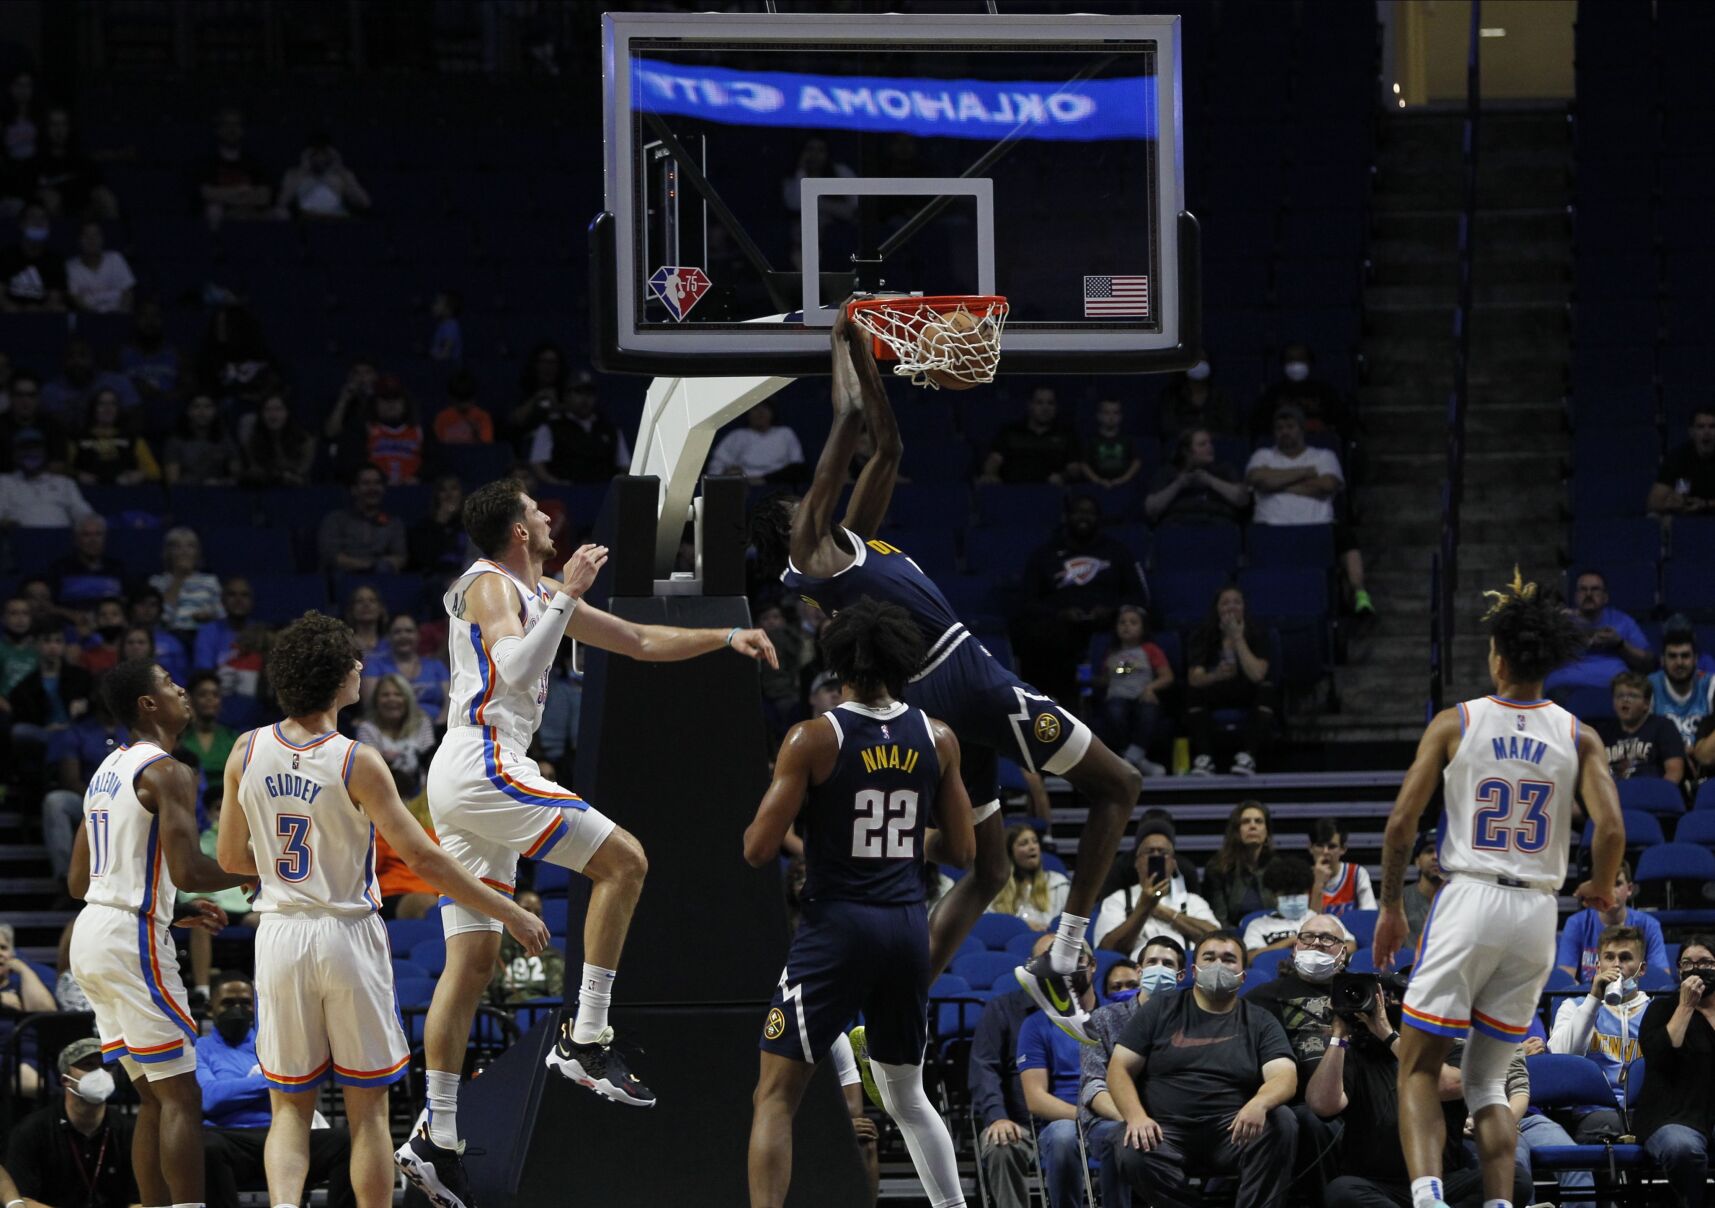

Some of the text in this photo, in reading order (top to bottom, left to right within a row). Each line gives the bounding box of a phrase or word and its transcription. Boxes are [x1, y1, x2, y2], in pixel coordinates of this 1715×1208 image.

[686, 275, 698, 292] 75
[861, 744, 919, 774] NNAJI
[1492, 736, 1547, 764] MANN
[265, 773, 322, 805] GIDDEY
[852, 789, 919, 858] 22
[1472, 777, 1554, 854] 23
[89, 809, 109, 878] 11
[275, 813, 314, 884] 3
